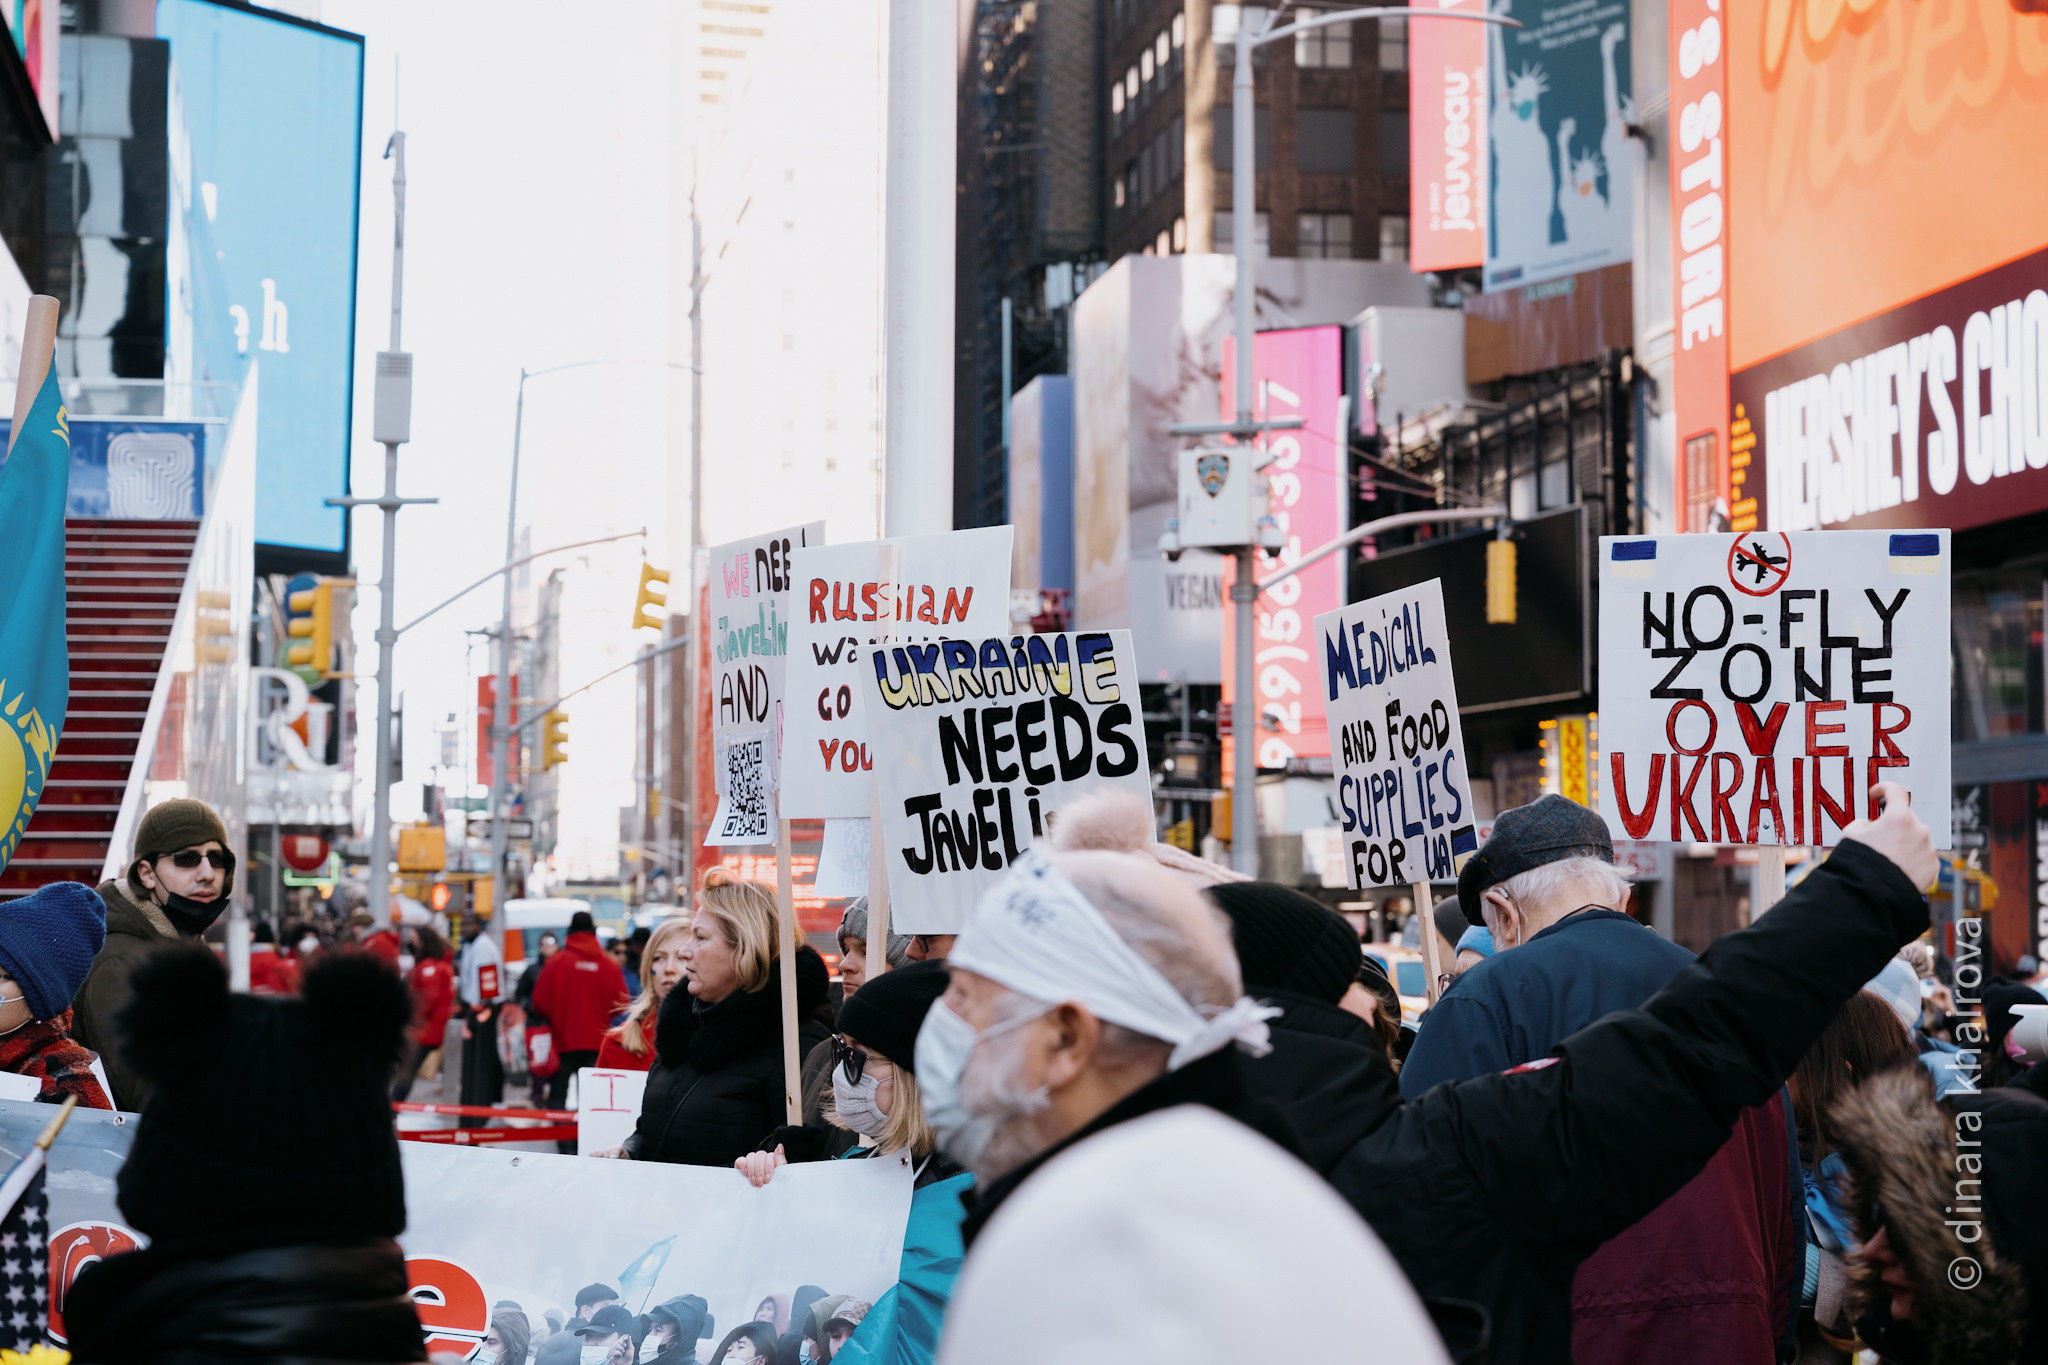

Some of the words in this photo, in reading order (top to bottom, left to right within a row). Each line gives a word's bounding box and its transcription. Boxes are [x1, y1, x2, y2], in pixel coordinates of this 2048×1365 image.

[1679, 91, 1724, 350] STORE
[1765, 324, 1959, 531] HERSHEY'S
[722, 553, 749, 598] WE
[1642, 585, 1911, 651] NO-FLY
[721, 665, 770, 727] AND
[818, 684, 852, 721] GO
[1650, 642, 1894, 704] ZONE
[939, 696, 1139, 787] NEEDS
[1342, 719, 1377, 769] AND
[1665, 699, 1912, 758] OVER
[902, 787, 1054, 875] JAVELi
[1352, 838, 1407, 889] FOR
[1423, 833, 1452, 882] UA
